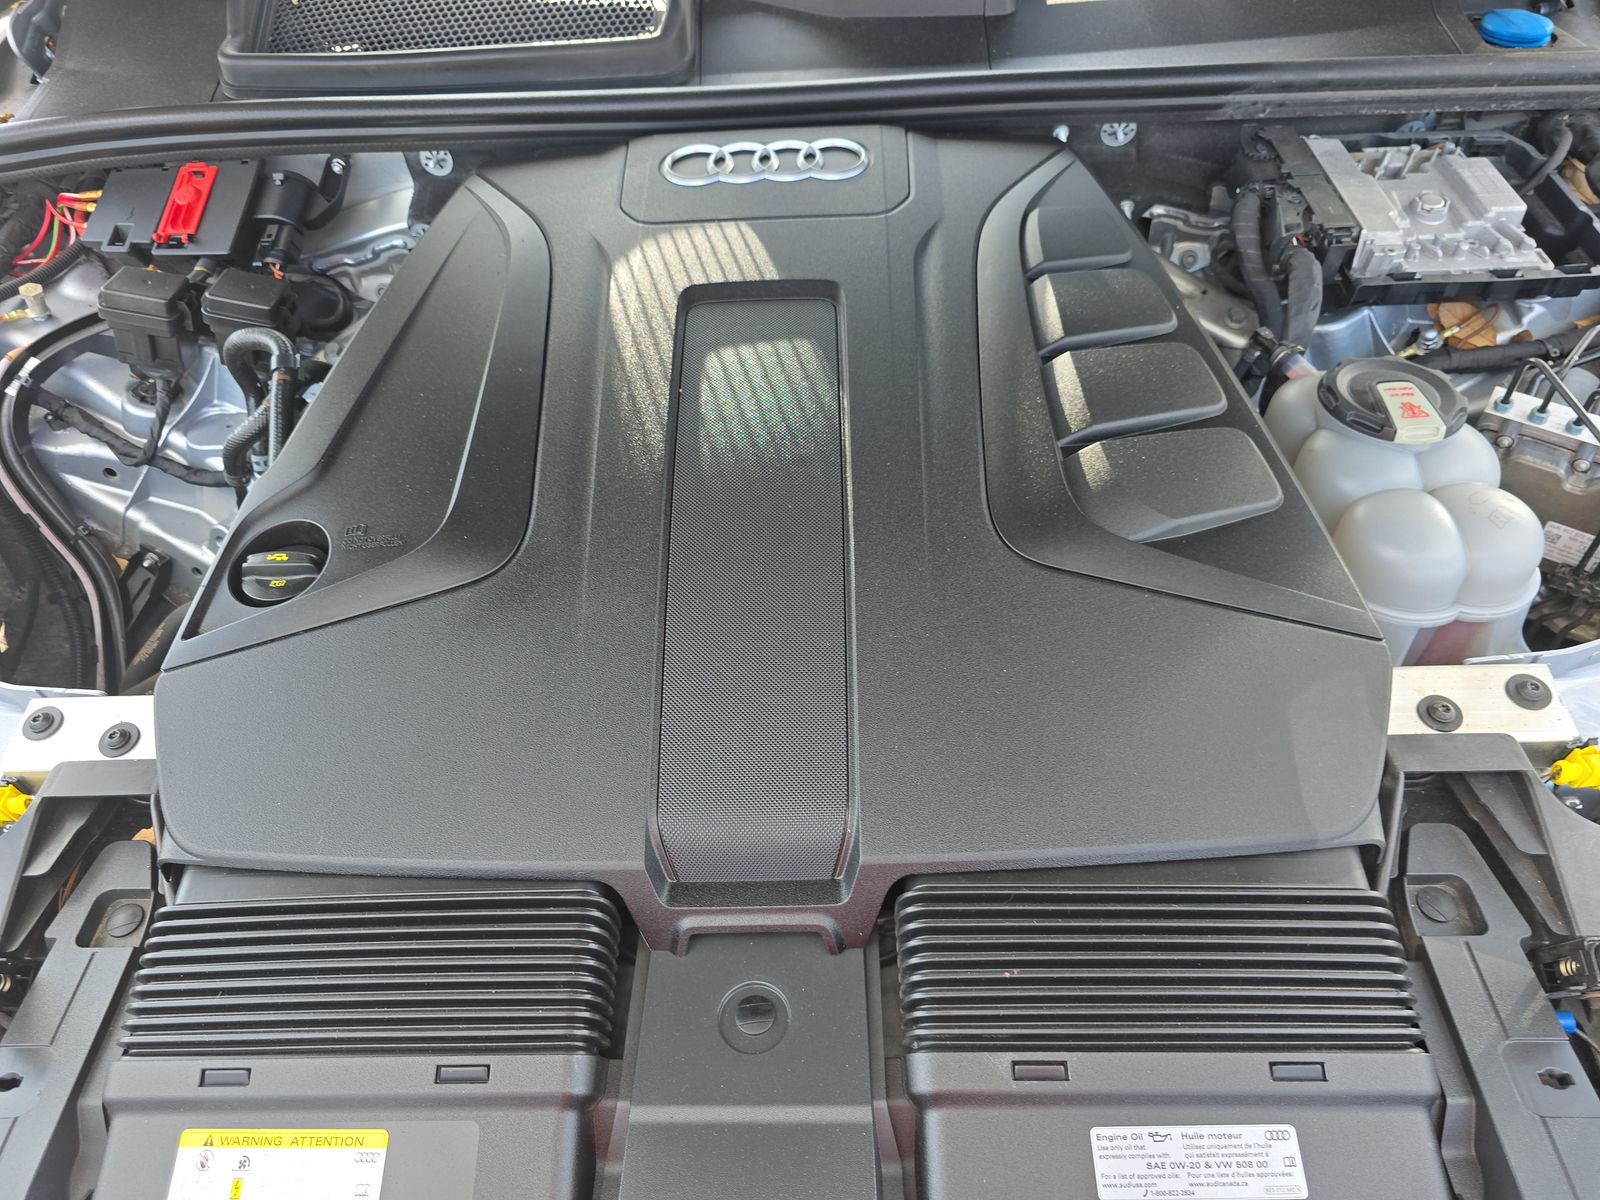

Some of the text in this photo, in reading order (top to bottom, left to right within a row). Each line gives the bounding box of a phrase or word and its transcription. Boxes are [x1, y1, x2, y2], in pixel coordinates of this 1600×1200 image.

[1096, 1133, 1143, 1142] Engine Oil
[1181, 1132, 1243, 1140] Huile moteur
[219, 1136, 365, 1147] WARNING ATTENTION
[1146, 1161, 1167, 1170] SAE
[1169, 1161, 1201, 1170] 0W-20
[1204, 1161, 1212, 1169] &
[1215, 1161, 1233, 1169] VW
[1235, 1161, 1253, 1169] 508
